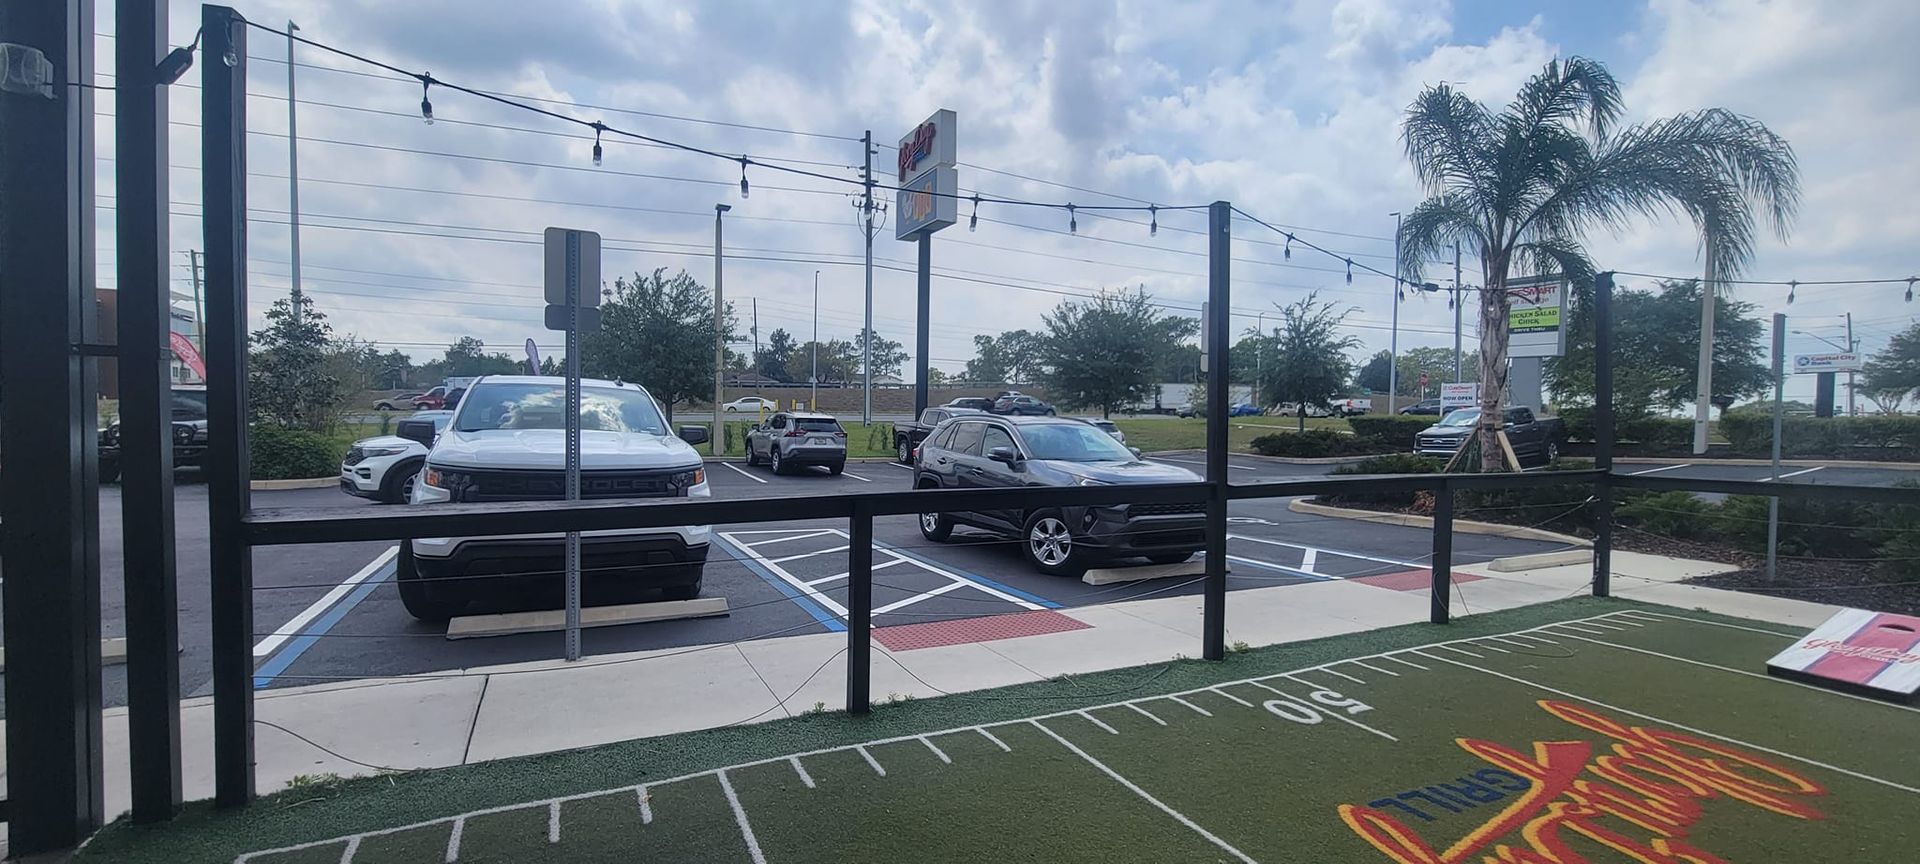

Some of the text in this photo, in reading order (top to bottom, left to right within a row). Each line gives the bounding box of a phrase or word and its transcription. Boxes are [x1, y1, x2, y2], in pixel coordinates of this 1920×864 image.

[1511, 311, 1533, 319] HICKEN
[1263, 690, 1376, 724] 50
[1369, 767, 1533, 823] GRILL
